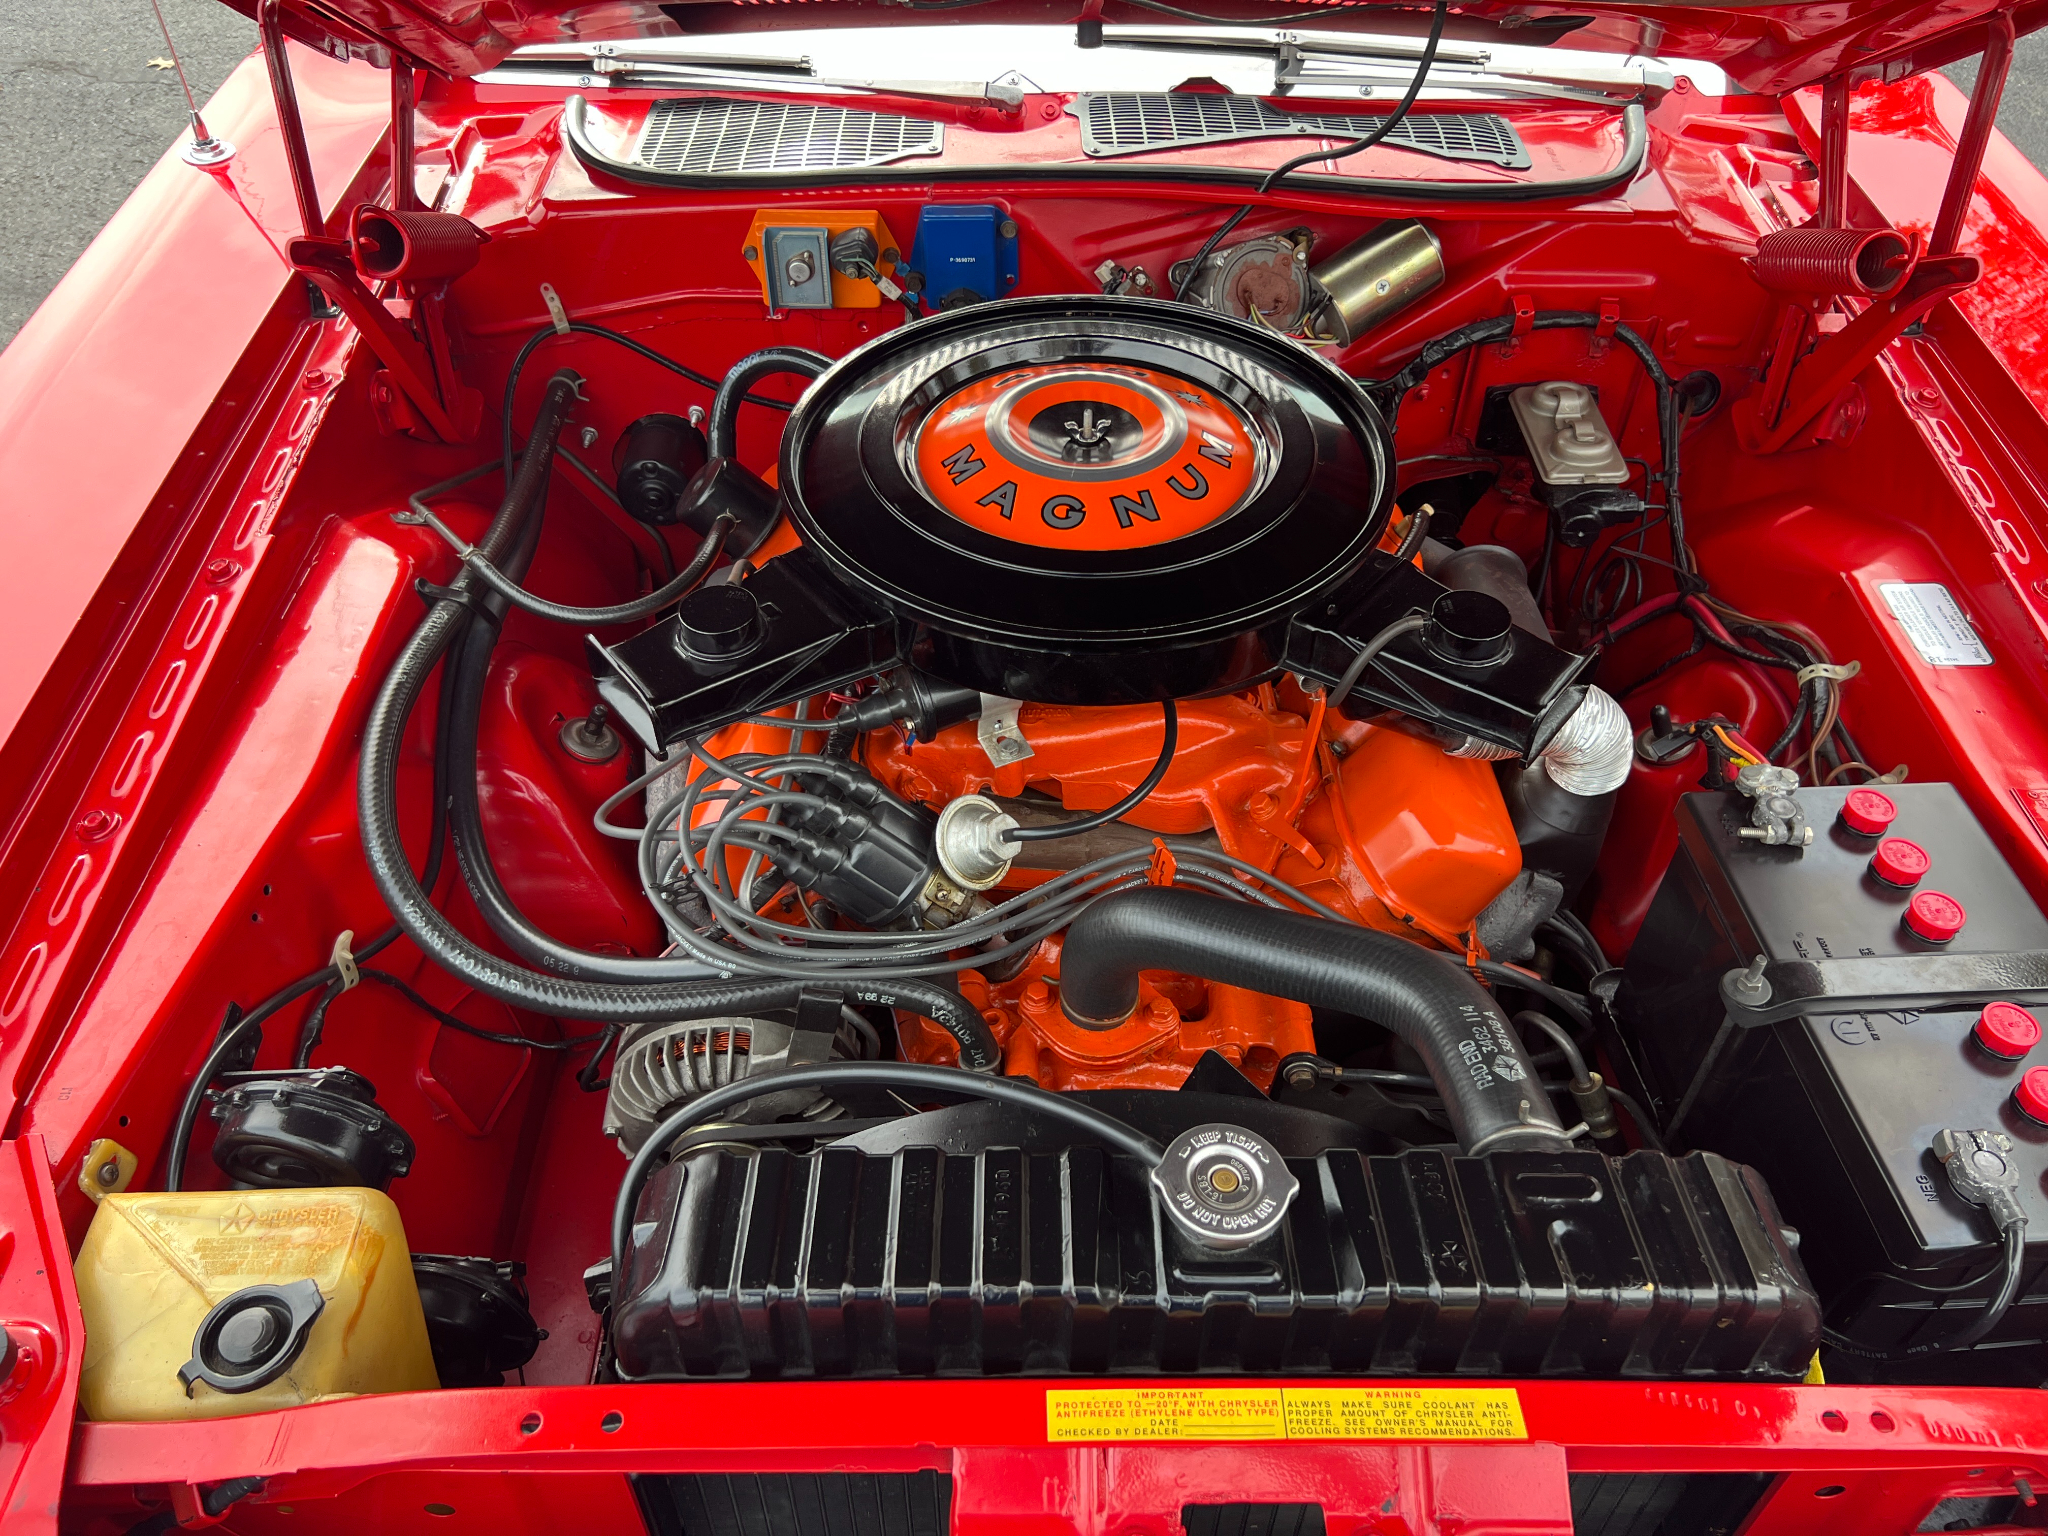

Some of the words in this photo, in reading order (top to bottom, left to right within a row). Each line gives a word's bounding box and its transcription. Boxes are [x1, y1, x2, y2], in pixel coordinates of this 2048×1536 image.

[941, 429, 1235, 530] MAGNUM
[676, 934, 693, 950] JACKET
[692, 948, 706, 959] Made
[714, 959, 726, 967] USA
[558, 961, 569, 973] 22
[880, 995, 896, 1005] 22
[1459, 1004, 1482, 1022] 114
[1472, 1025, 1498, 1054] 3462
[1458, 1039, 1482, 1066] END
[1191, 1131, 1221, 1148] KEEP
[1225, 1131, 1261, 1153] TIGHT
[1197, 1175, 1223, 1202] 16-LBS
[1916, 1174, 1940, 1203] NEG
[257, 1205, 340, 1220] CHRYSLER
[1176, 1192, 1195, 1210] DO
[1192, 1205, 1221, 1227] NOT
[1222, 1212, 1258, 1230] OPEN
[1256, 1196, 1277, 1220] HOT
[1137, 1391, 1204, 1399] IMPORTANT
[1365, 1390, 1422, 1399] WARNING
[1056, 1401, 1123, 1409] PROTECTED
[1219, 1399, 1278, 1408] CHRYSLER
[1287, 1400, 1331, 1408] ALWAYS
[1342, 1401, 1372, 1409] MAKE
[1383, 1401, 1412, 1409] SURE
[1423, 1401, 1475, 1409] COOLANT
[1056, 1409, 1126, 1418] ANTIFREEZE
[1130, 1408, 1193, 1417] (ETHYLENE
[1198, 1408, 1242, 1417] GLYCOL
[1247, 1408, 1280, 1417] TYPE)
[1393, 1410, 1408, 1418] OF
[1415, 1410, 1474, 1418] CHRYSLER
[1481, 1410, 1511, 1418] ANTI-
[1150, 1419, 1178, 1427] DATE
[1289, 1418, 1336, 1426] FREEZE.
[1345, 1418, 1366, 1426] SEE
[1375, 1418, 1426, 1427] OWNER'S
[1435, 1419, 1482, 1427] MANUAL
[1491, 1419, 1513, 1427] FOR
[1057, 1428, 1110, 1436] CHECKED
[1116, 1428, 1130, 1436] BY
[1134, 1427, 1183, 1436] DEALER:
[1290, 1427, 1340, 1435] COOLING
[1344, 1427, 1395, 1435] SYSTEMS
[1400, 1427, 1516, 1436] RECOMMENDATIONS.
